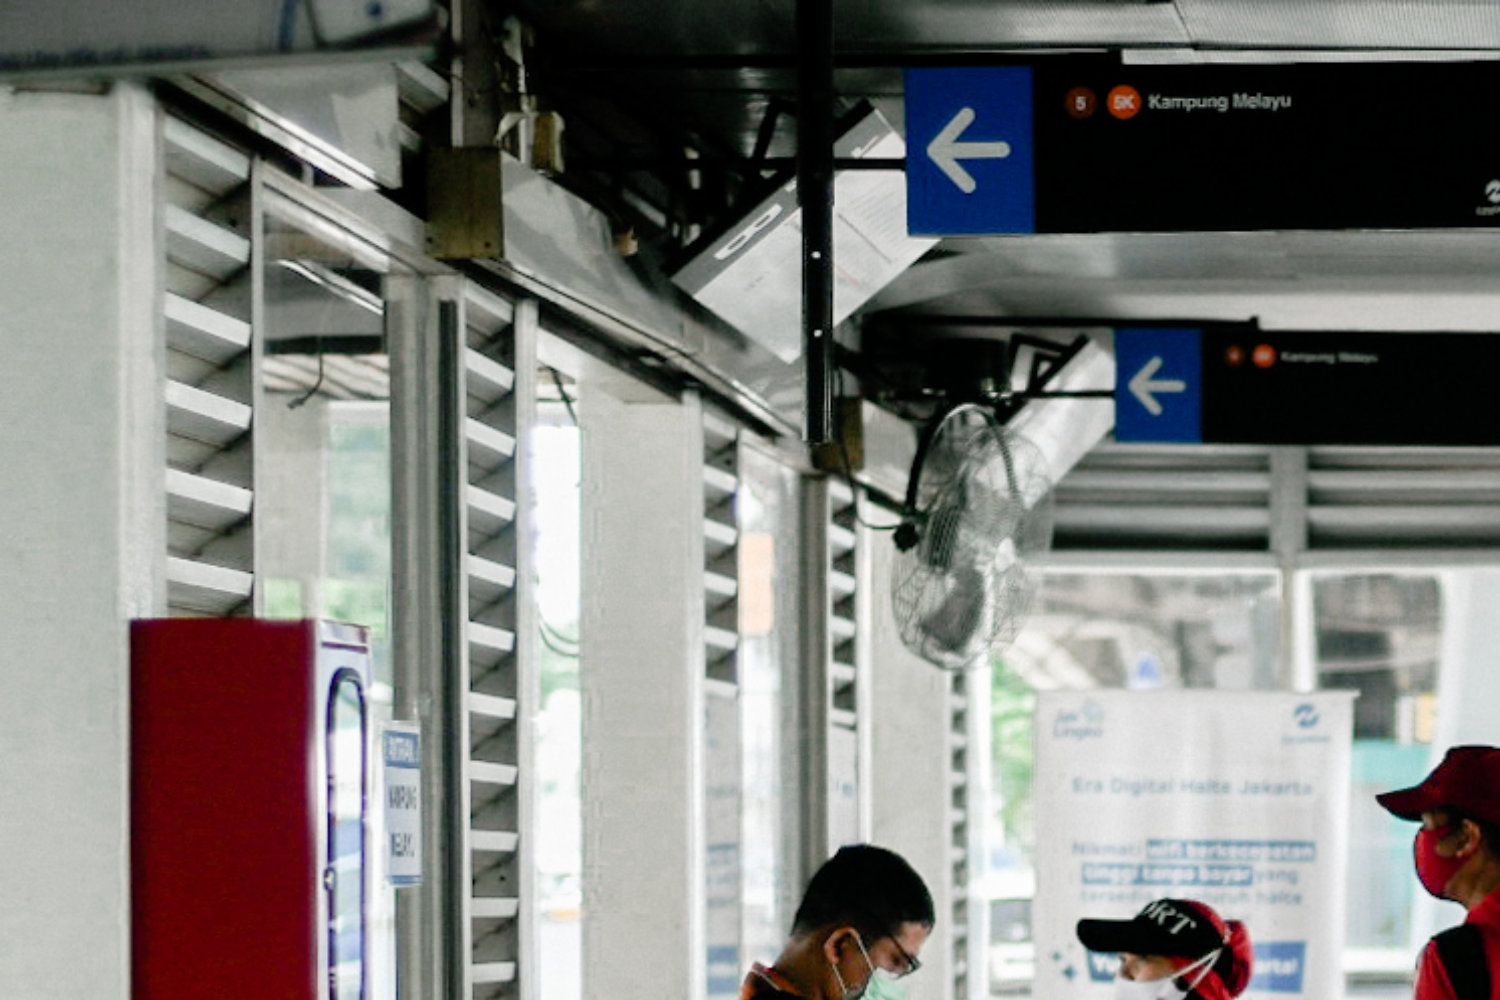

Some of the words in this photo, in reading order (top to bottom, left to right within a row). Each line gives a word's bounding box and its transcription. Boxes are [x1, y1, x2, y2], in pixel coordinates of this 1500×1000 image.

[1148, 94, 1229, 112] Kampung
[1232, 93, 1292, 111] Melayu
[1072, 777, 1102, 794] Era
[1111, 777, 1172, 797] Digital
[1181, 777, 1231, 794] Halte
[1240, 777, 1312, 796] Jakarta
